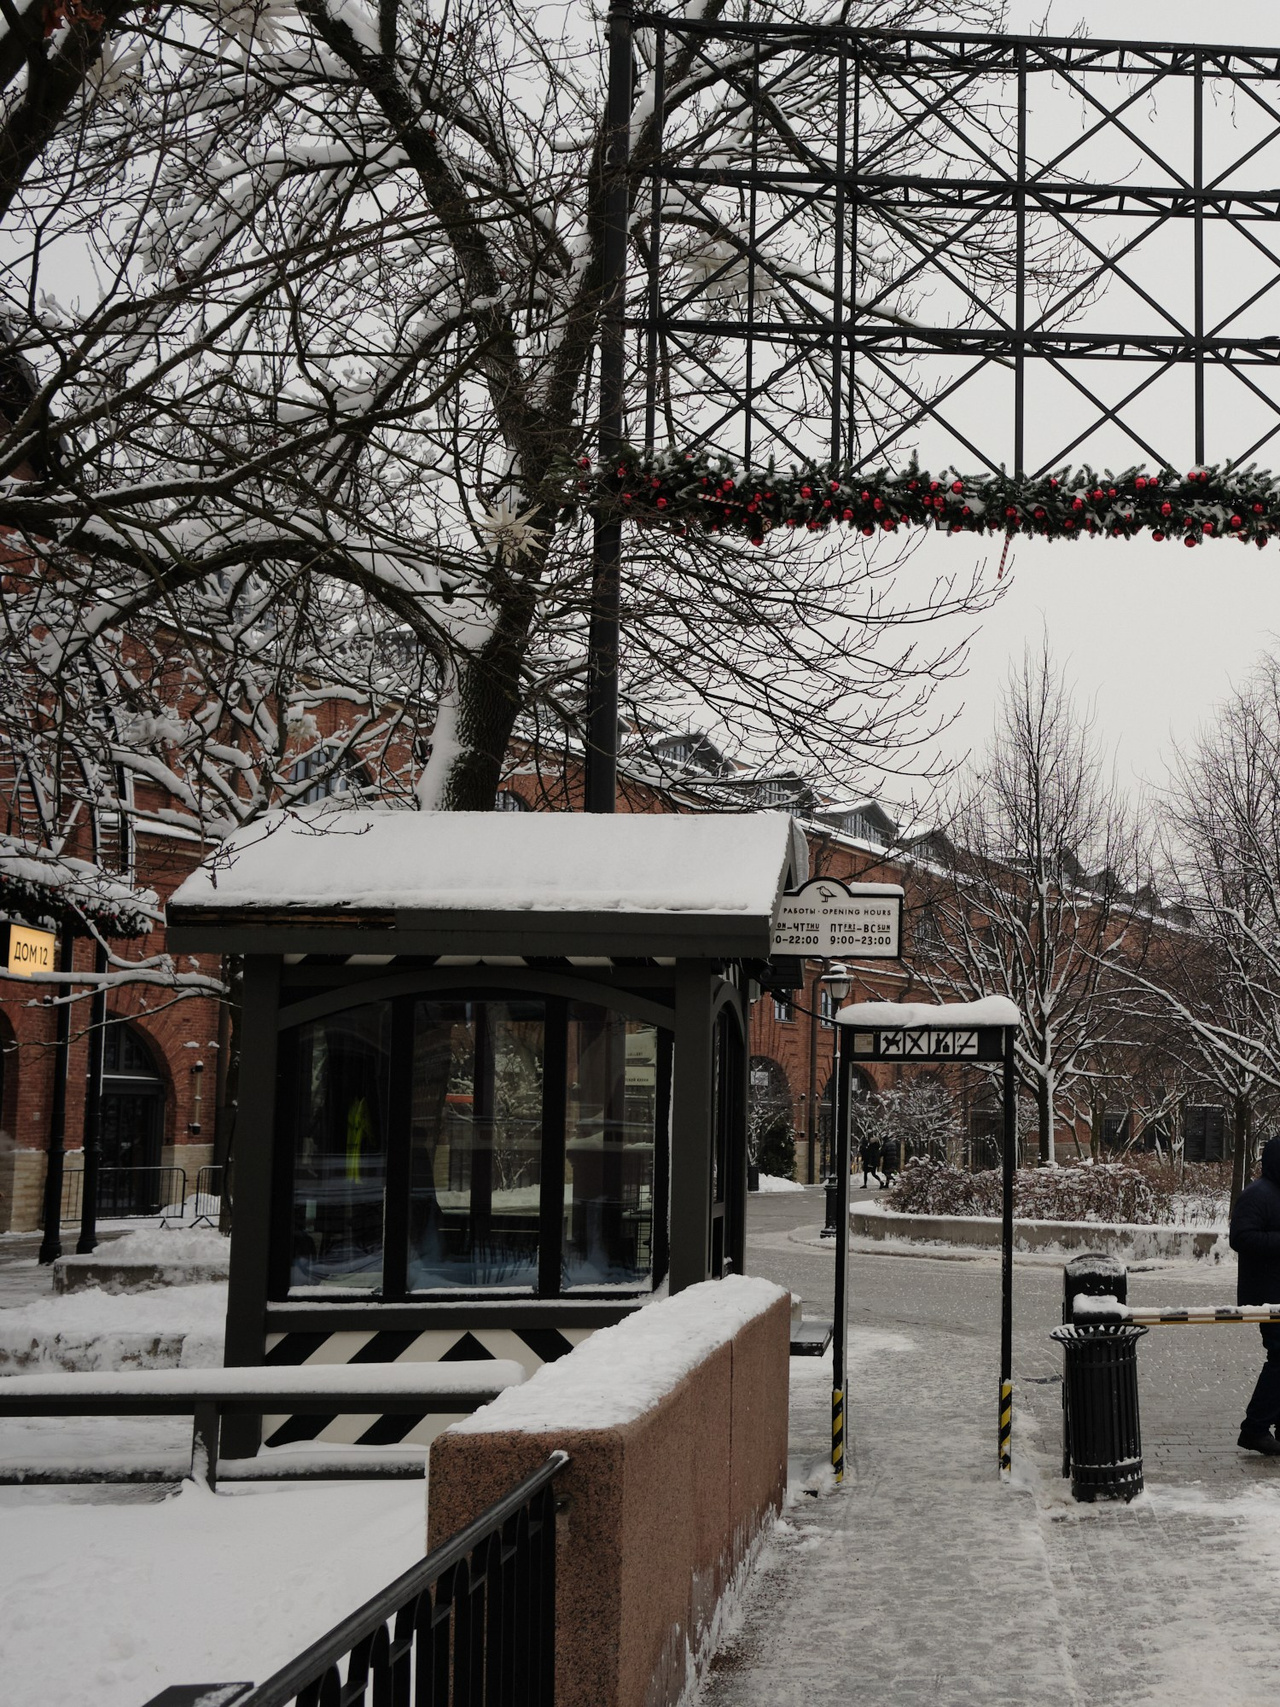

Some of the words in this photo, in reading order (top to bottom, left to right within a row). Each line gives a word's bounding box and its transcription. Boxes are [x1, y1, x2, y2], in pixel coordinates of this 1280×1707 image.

[773, 935, 819, 944] 0-22:00
[14, 941, 37, 963] ДОМ
[39, 946, 48, 966] 12
